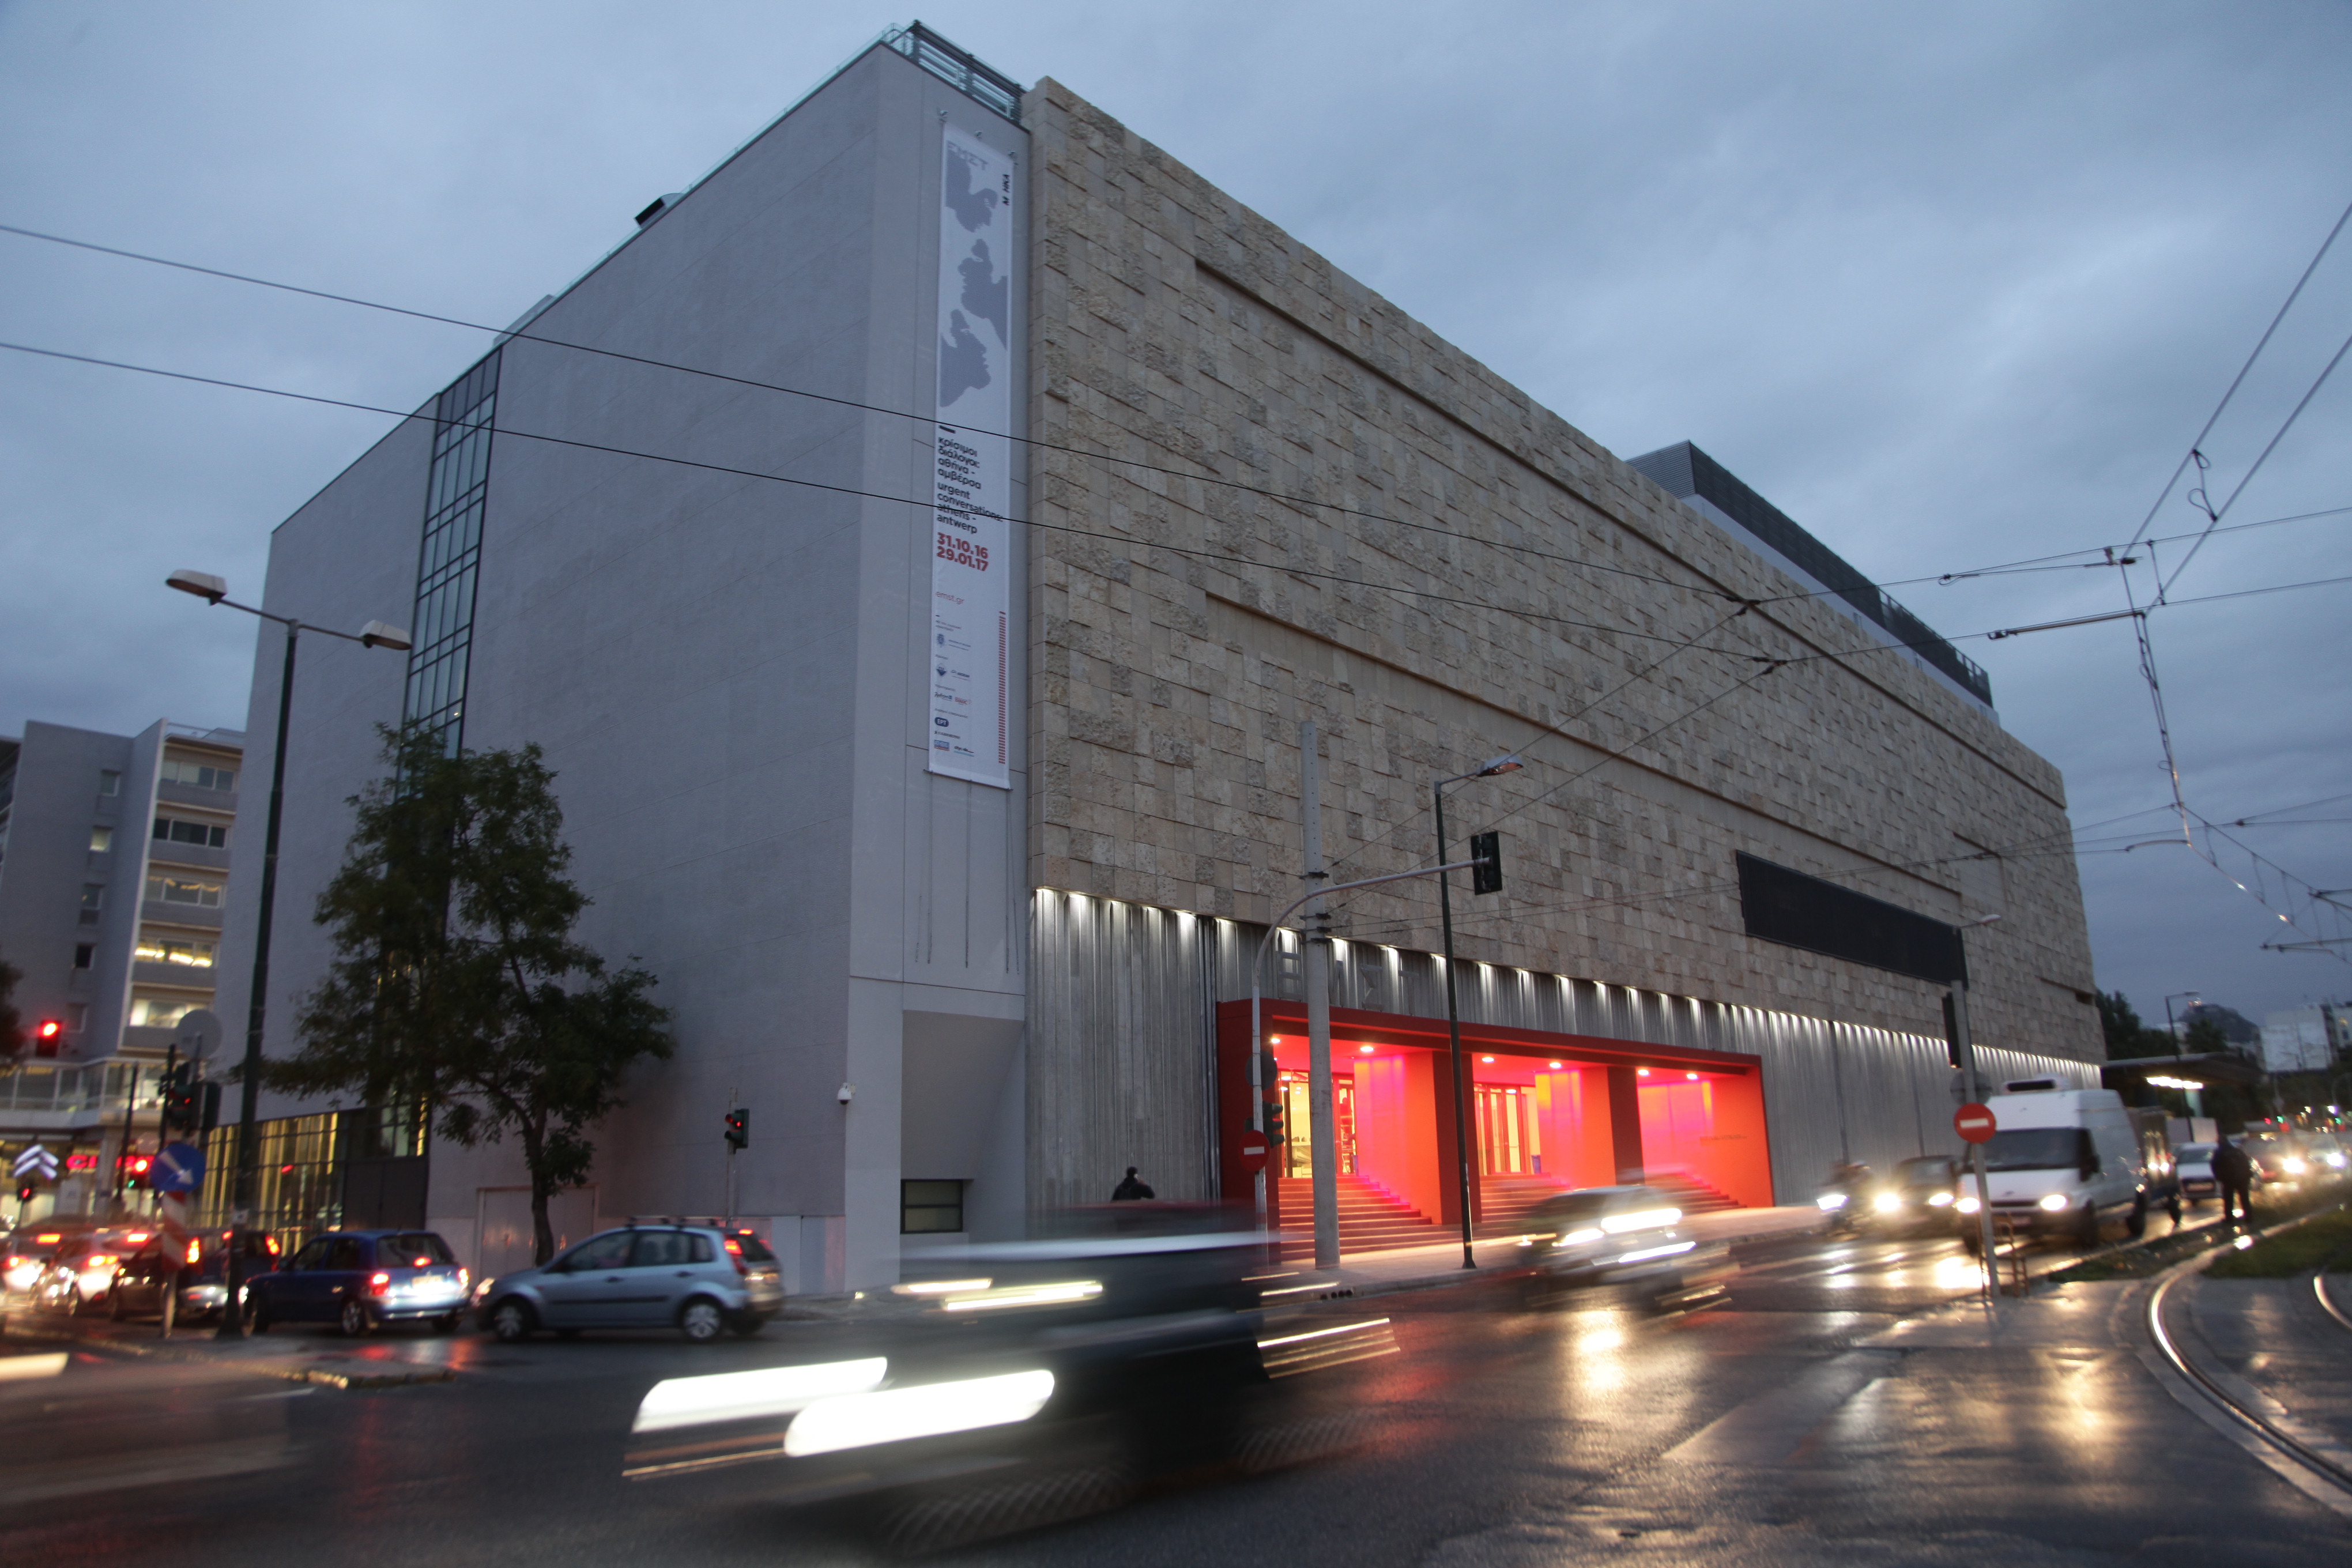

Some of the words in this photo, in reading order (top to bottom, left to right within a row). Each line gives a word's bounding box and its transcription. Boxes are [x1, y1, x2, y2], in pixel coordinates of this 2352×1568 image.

[938, 457, 969, 474] αθήνα
[937, 467, 982, 489] αμβέρσα
[937, 481, 970, 499] urgent
[937, 502, 970, 521] athens
[937, 514, 978, 535] antwerp
[937, 532, 989, 559] 31.10.16
[936, 545, 989, 572] 29.01.17
